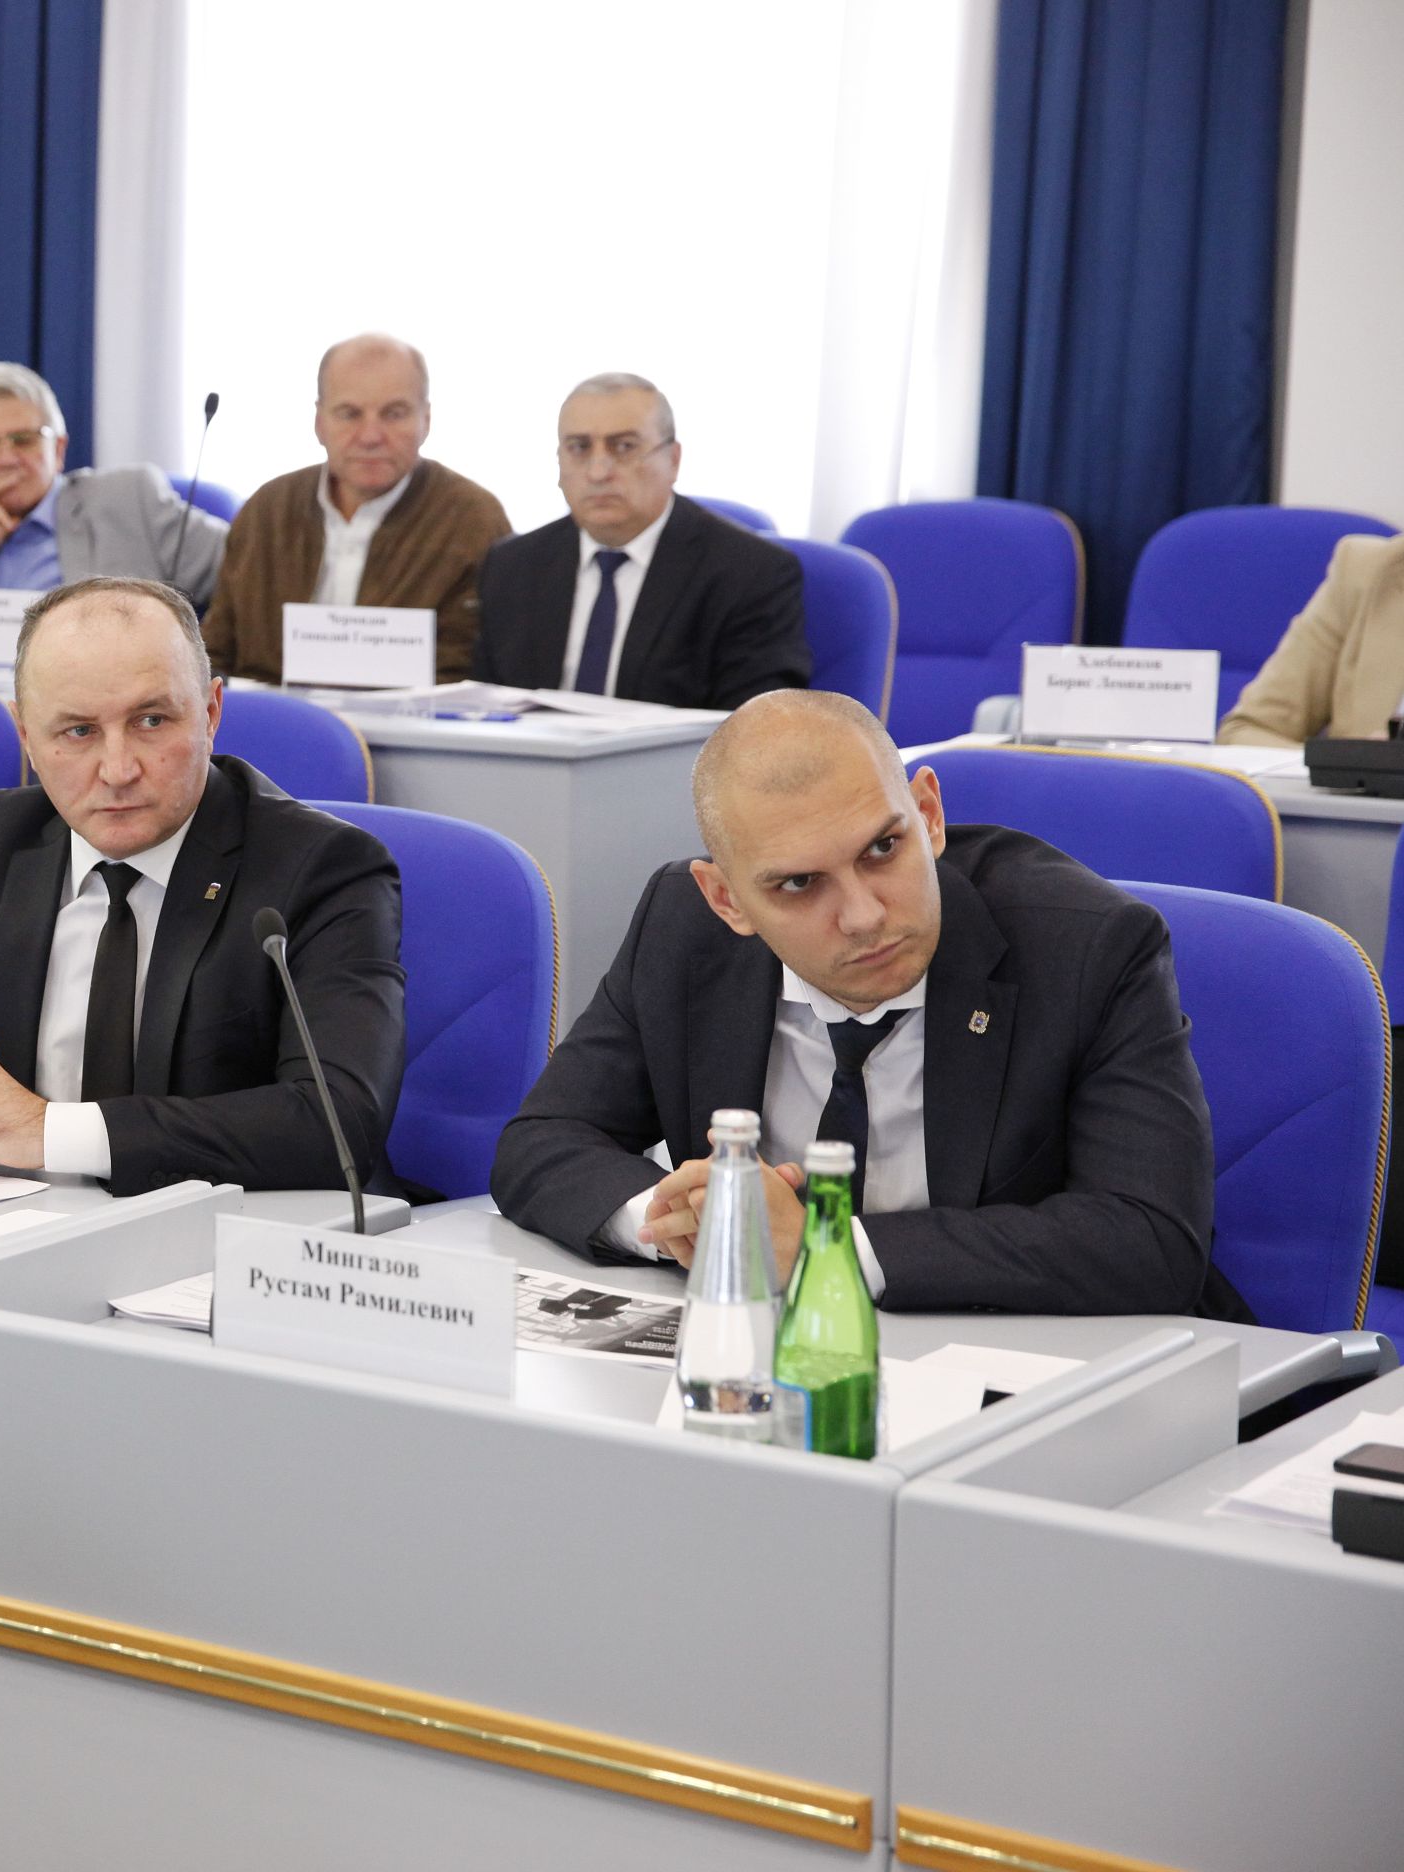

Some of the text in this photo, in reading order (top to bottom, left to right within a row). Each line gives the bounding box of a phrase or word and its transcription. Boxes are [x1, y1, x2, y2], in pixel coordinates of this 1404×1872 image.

[1047, 675, 1092, 691] Борис
[302, 1239, 420, 1279] Мингазов
[249, 1266, 474, 1326] Рустам Рамилевич
